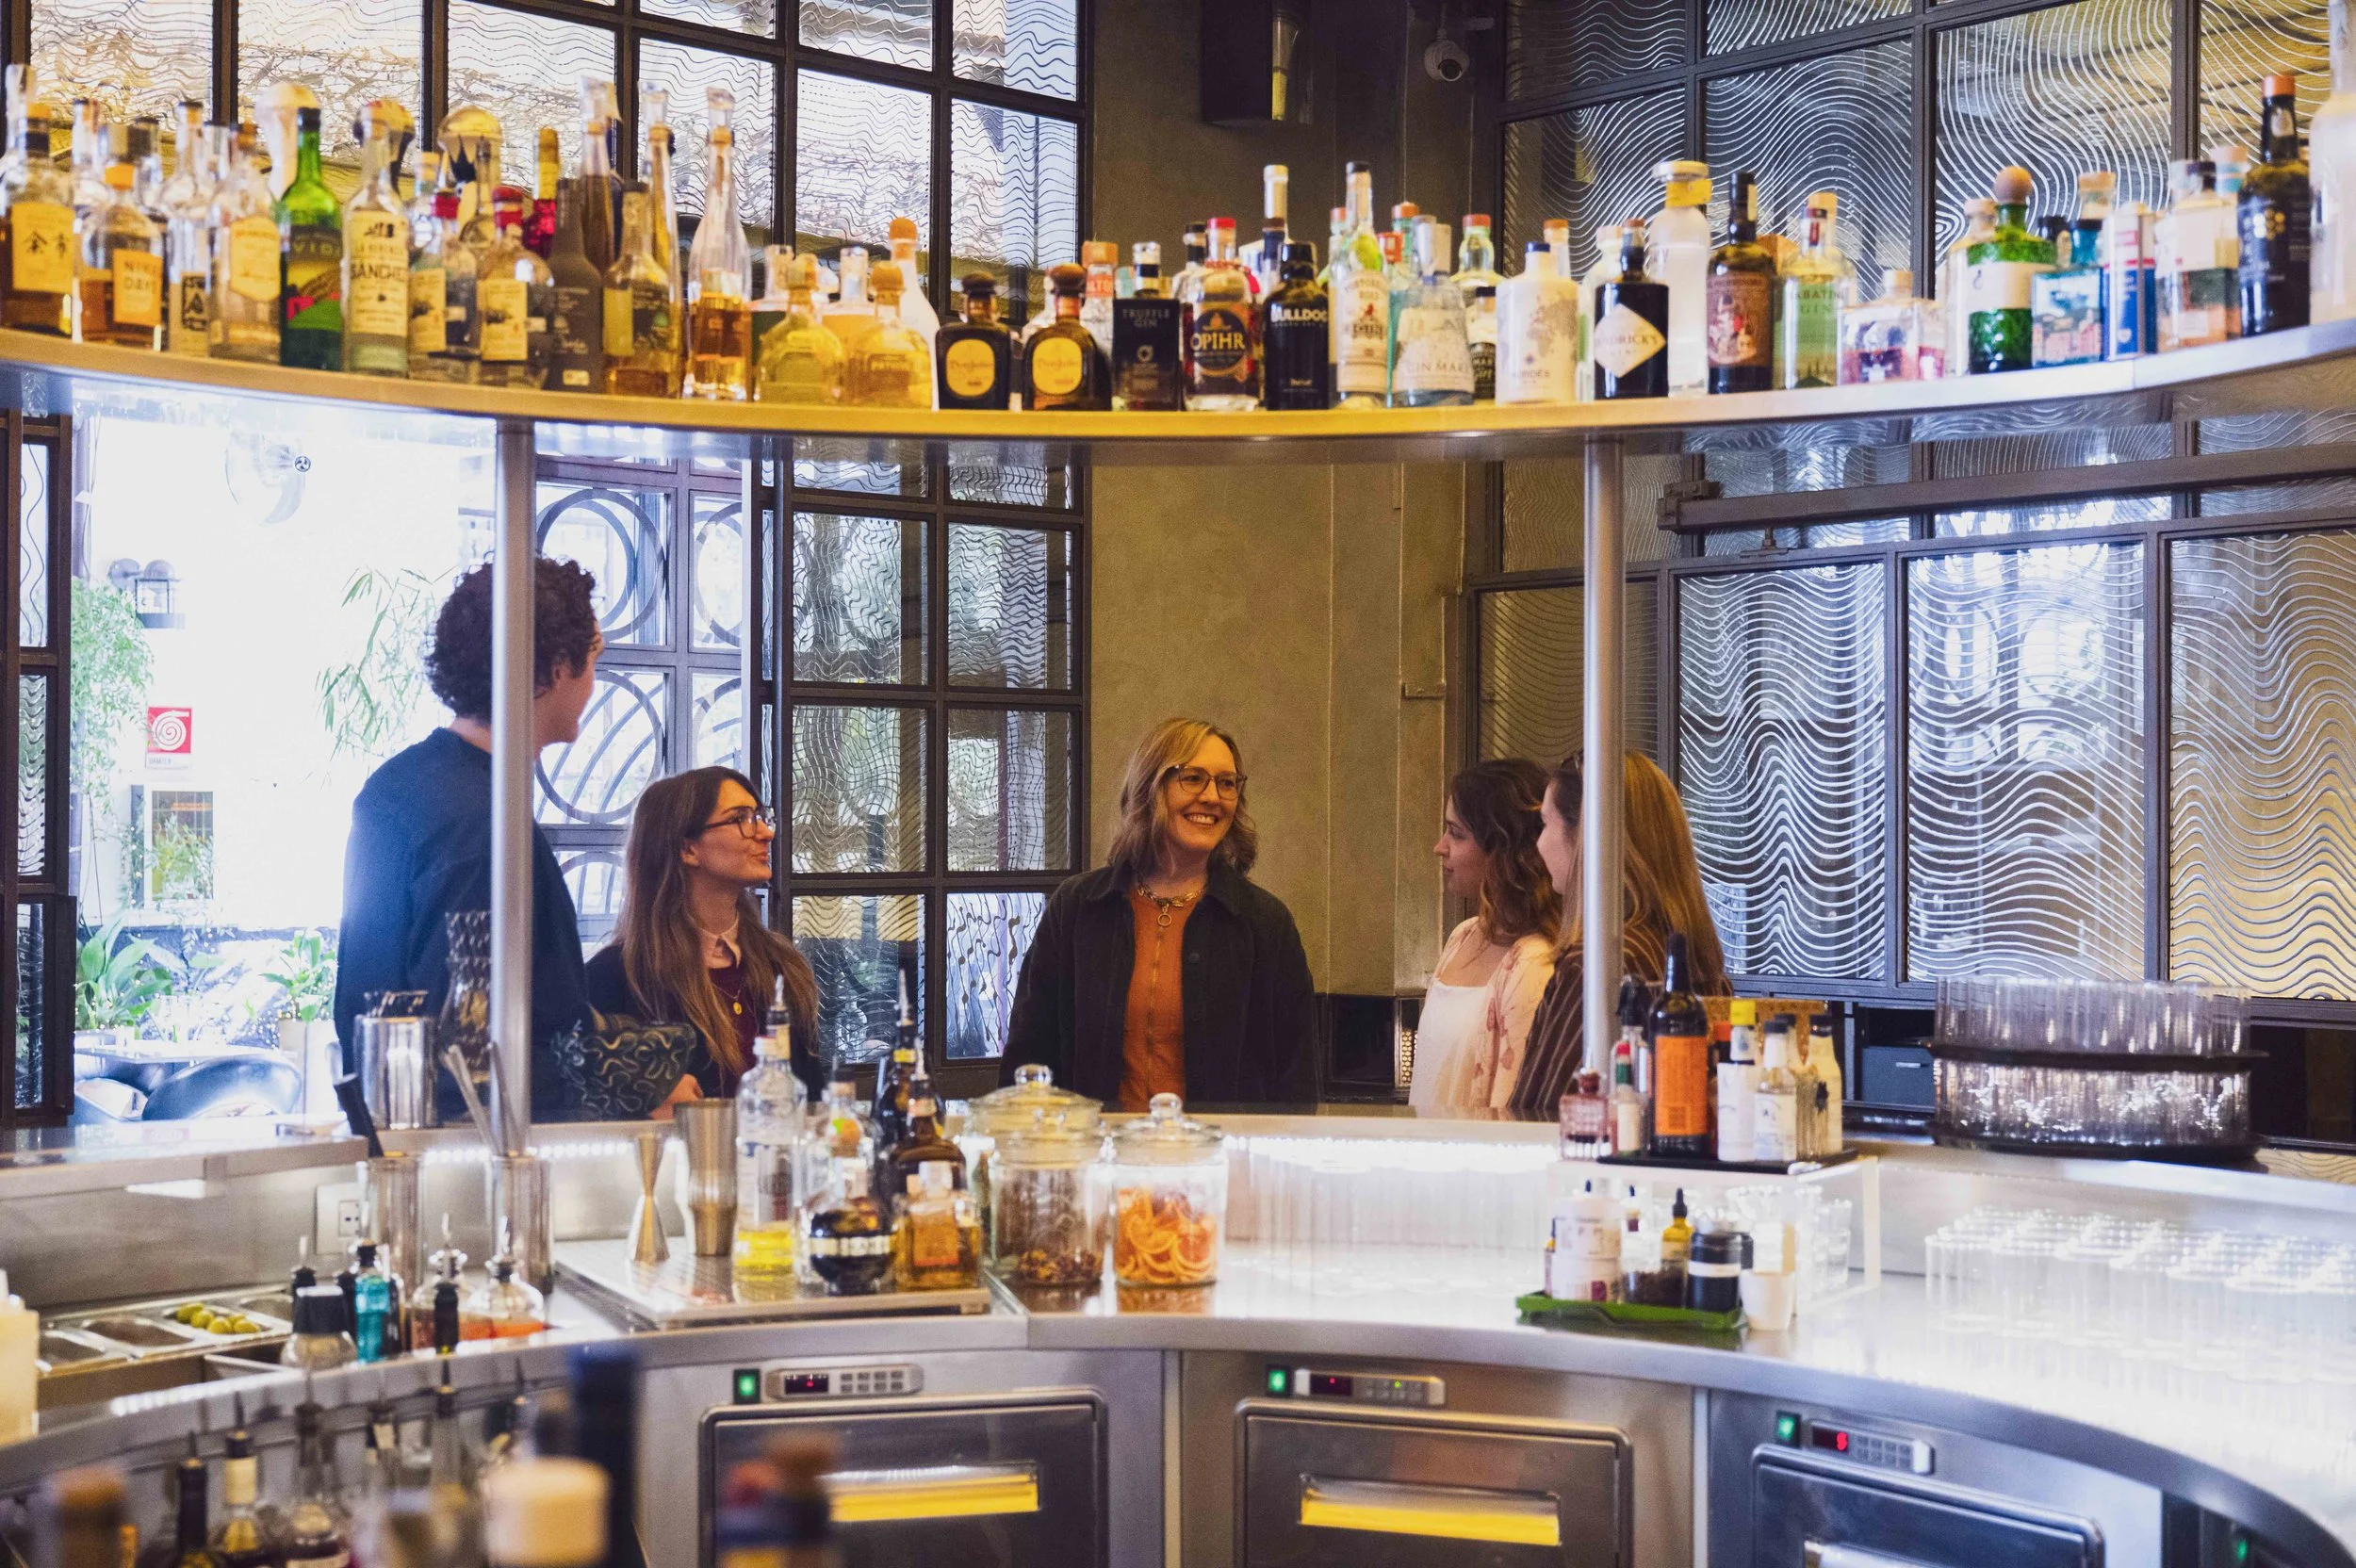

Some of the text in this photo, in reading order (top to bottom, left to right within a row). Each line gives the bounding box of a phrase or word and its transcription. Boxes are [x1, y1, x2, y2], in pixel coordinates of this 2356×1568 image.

[1121, 309, 1170, 319] TRUFFLE
[1134, 319, 1158, 328] GIN
[1189, 332, 1246, 351] OPIHR
